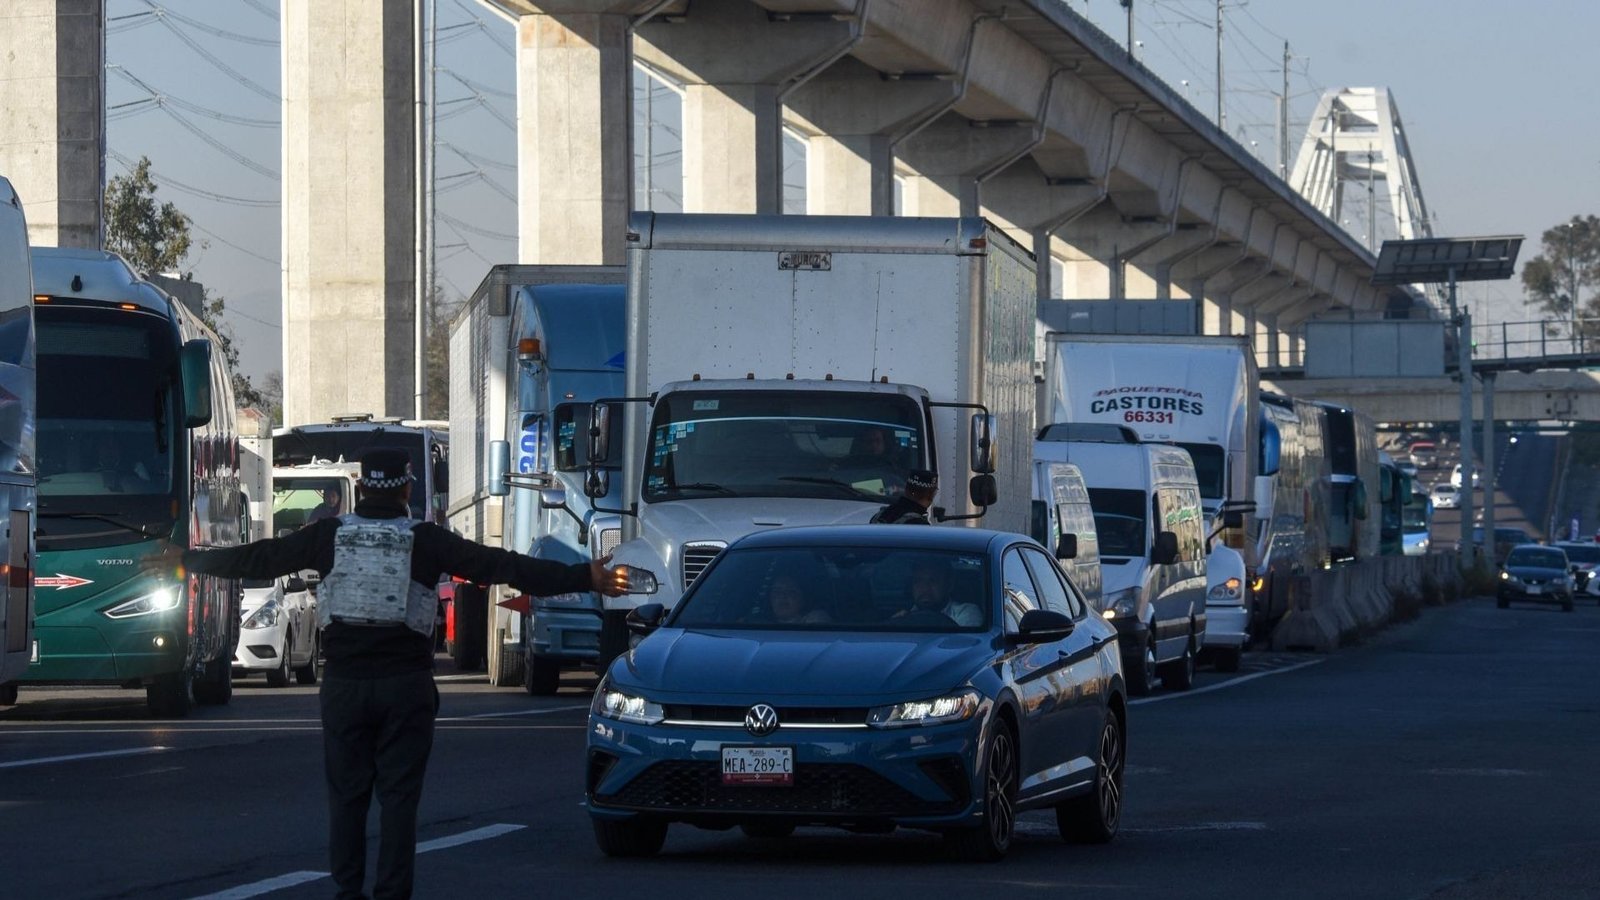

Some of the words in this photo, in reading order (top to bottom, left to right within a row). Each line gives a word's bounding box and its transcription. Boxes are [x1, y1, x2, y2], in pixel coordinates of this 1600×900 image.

[1093, 386, 1203, 399] PAQUETERIA
[1091, 396, 1204, 416] CASTORES
[1124, 411, 1174, 424] 66331
[724, 757, 790, 773] MEA-289-C
